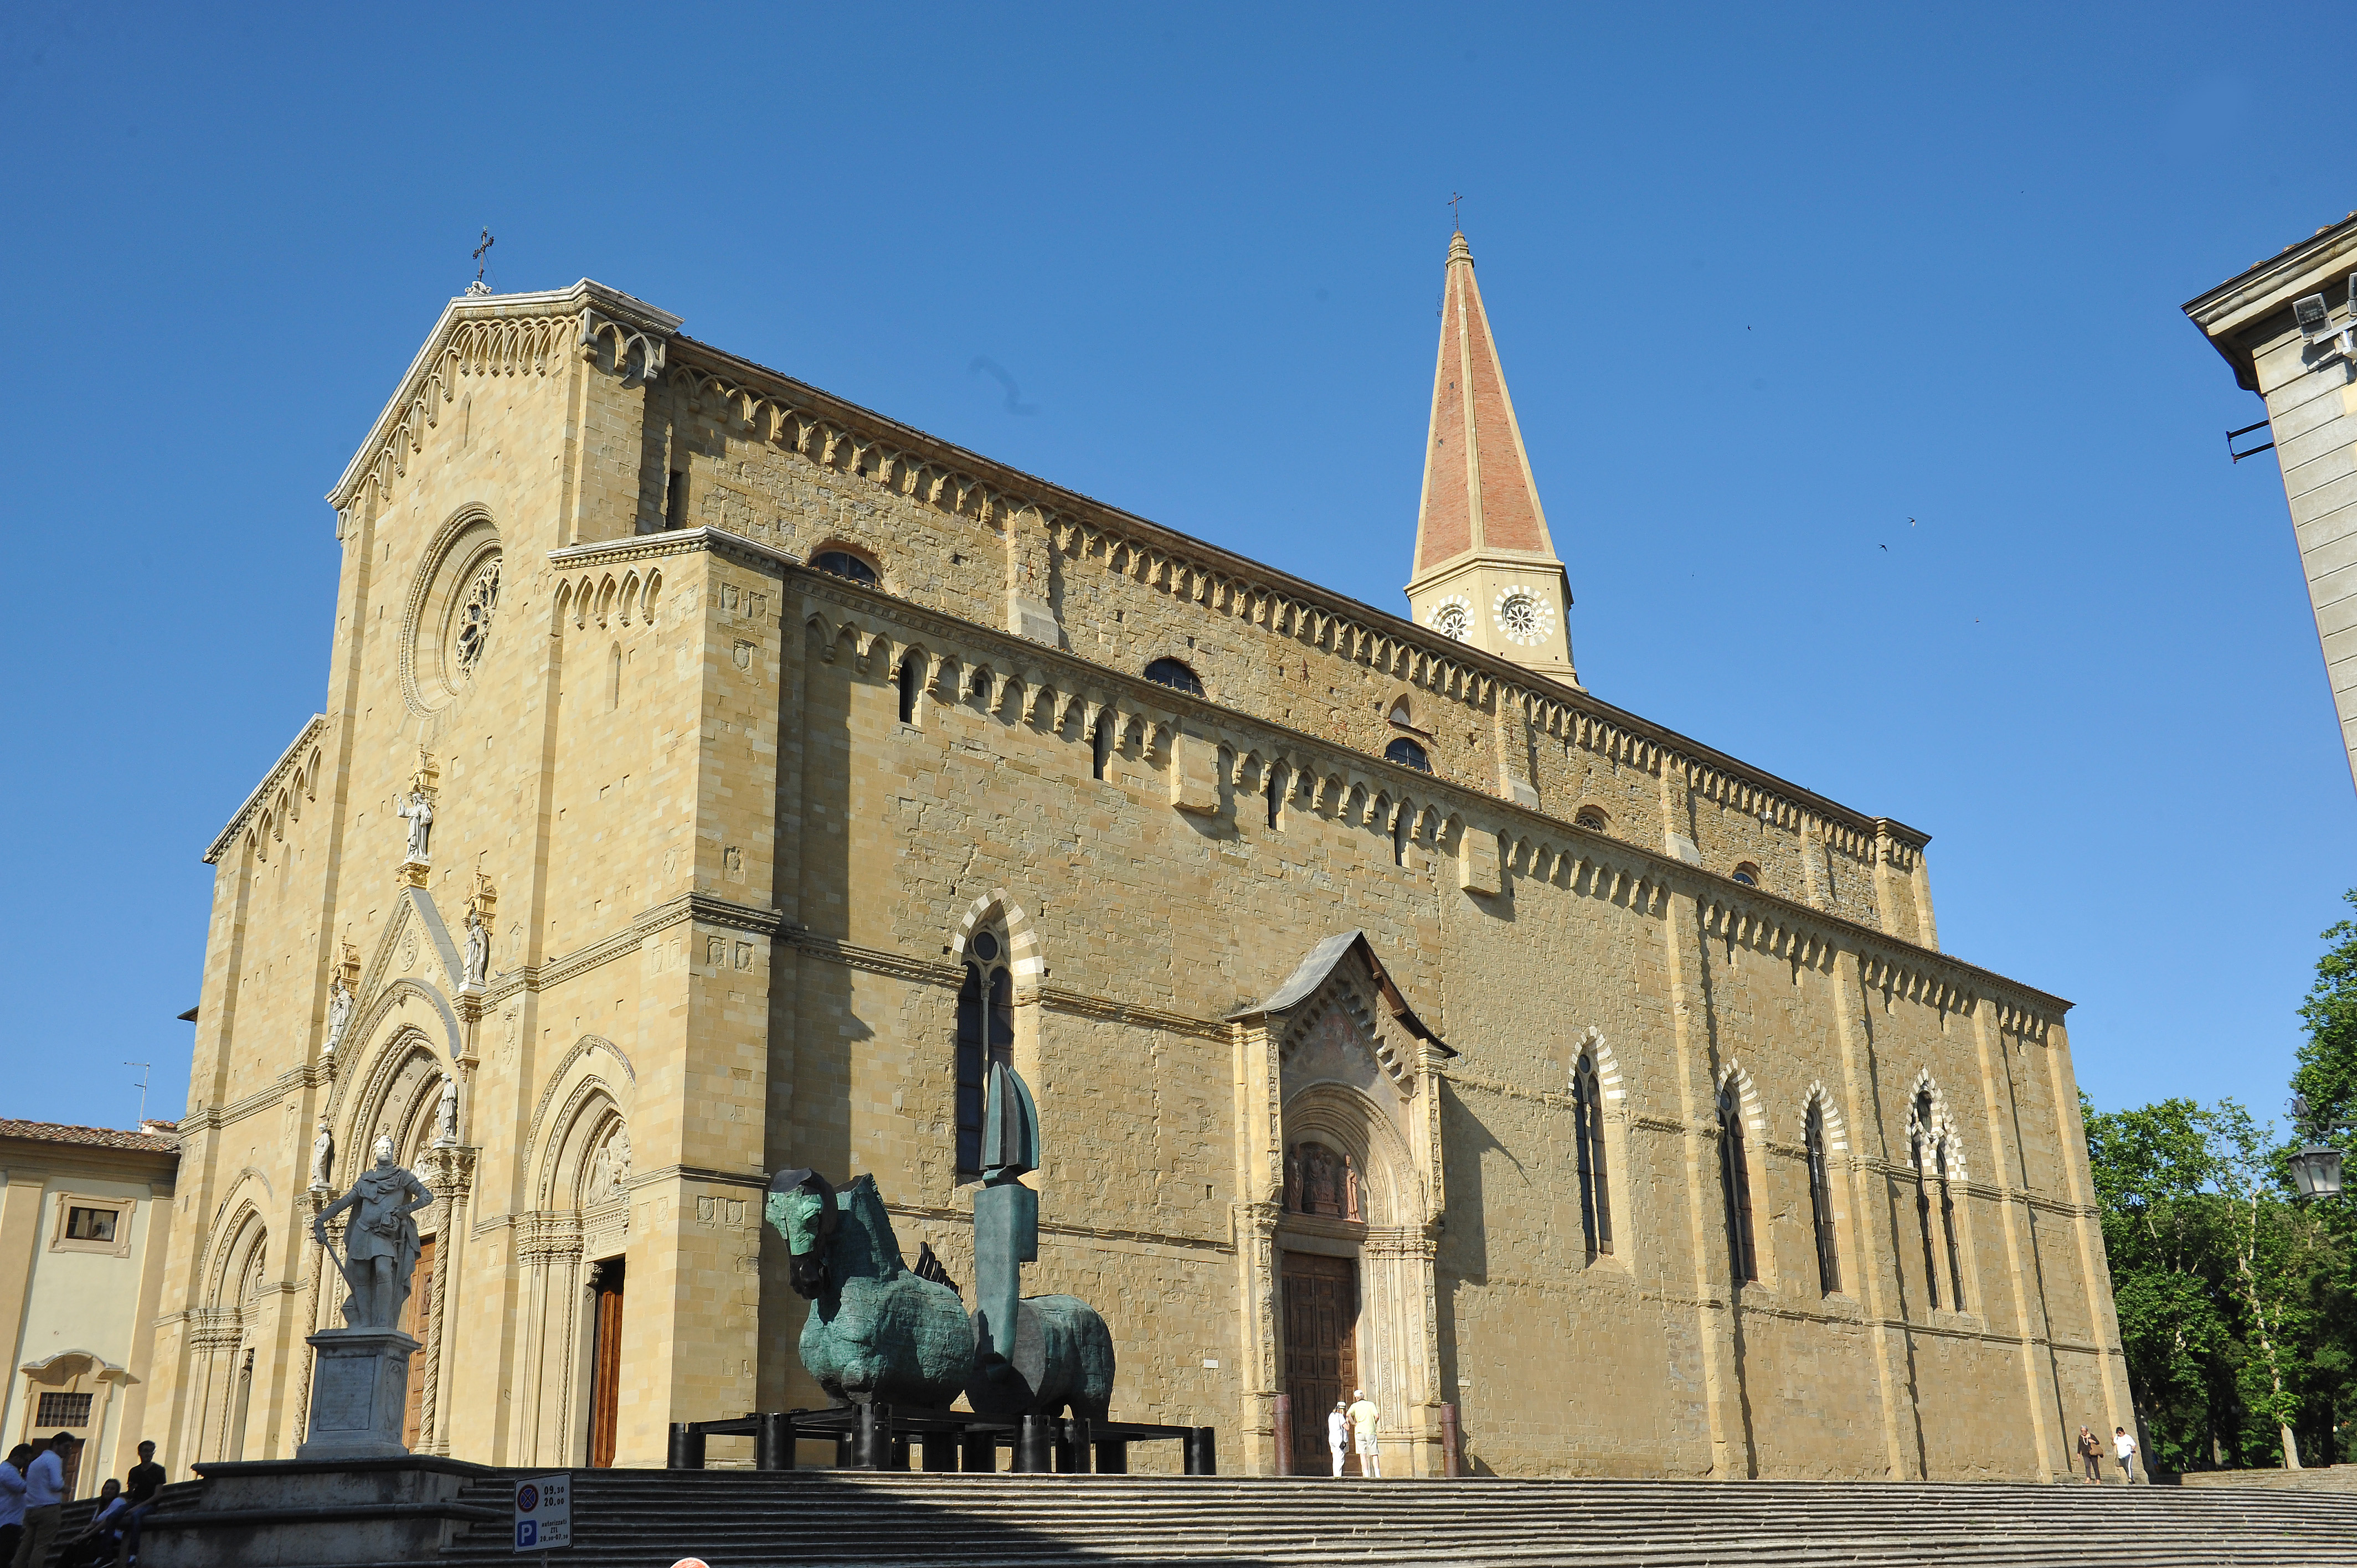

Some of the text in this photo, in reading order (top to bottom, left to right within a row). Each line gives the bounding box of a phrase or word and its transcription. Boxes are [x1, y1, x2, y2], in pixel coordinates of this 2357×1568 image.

[544, 1485, 564, 1495] 09.30
[544, 1497, 564, 1507] 20.00
[541, 1518, 567, 1528] autorizzati
[521, 1524, 533, 1544] P
